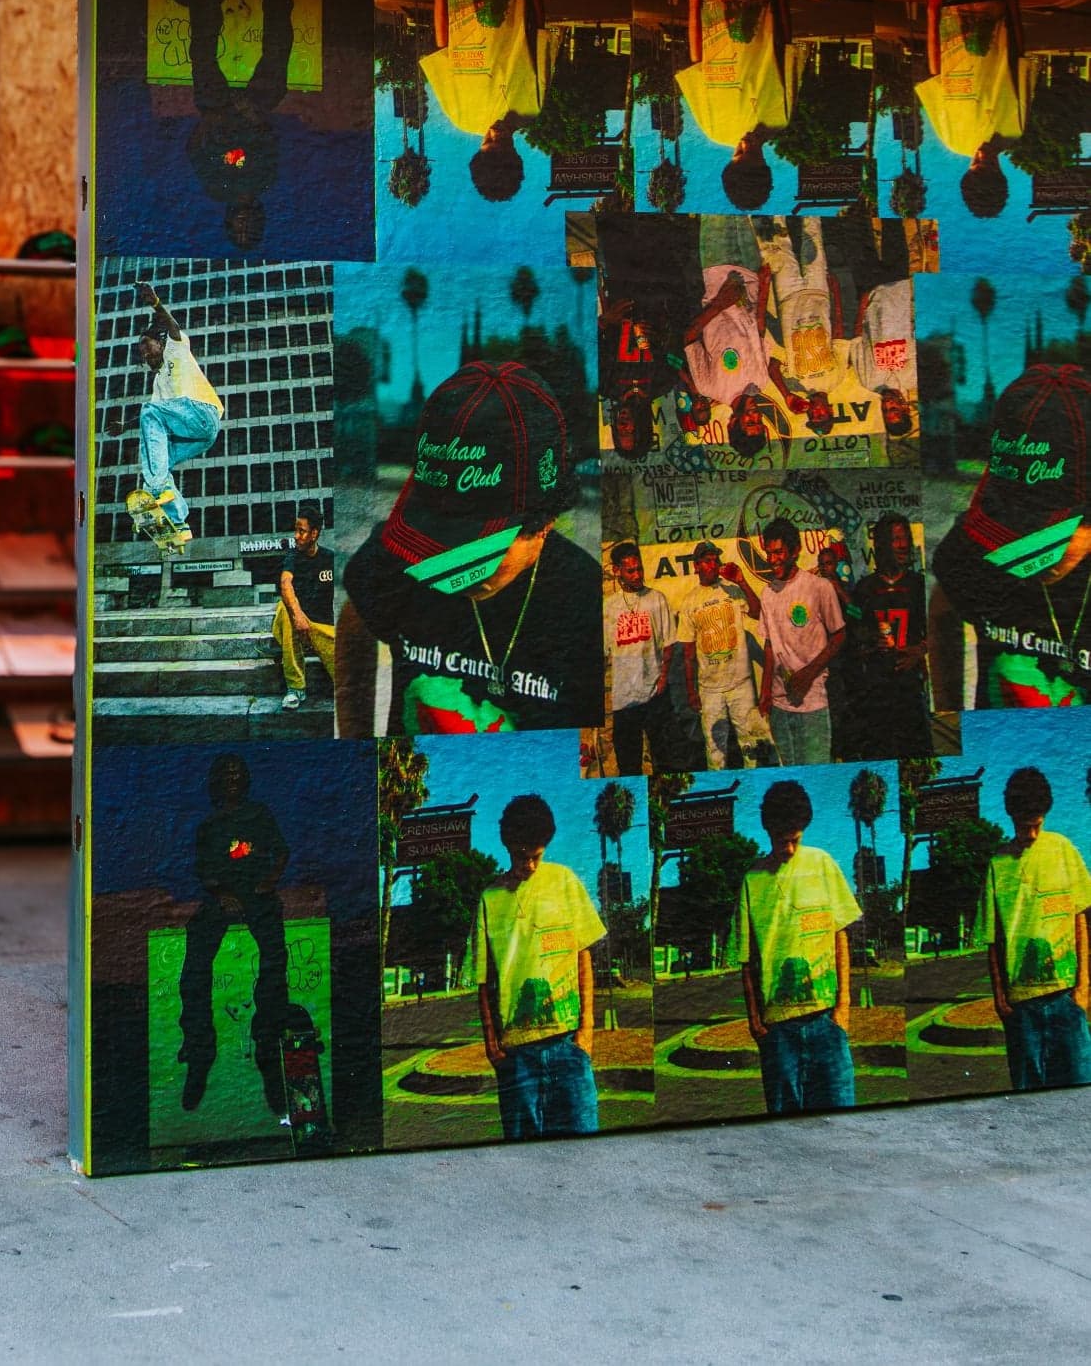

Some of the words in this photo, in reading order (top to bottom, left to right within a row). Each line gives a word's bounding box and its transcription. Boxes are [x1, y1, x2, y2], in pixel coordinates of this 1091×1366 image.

[804, 435, 871, 452] LOTTO
[457, 463, 503, 493] Club
[860, 481, 907, 494] HUGE
[656, 482, 675, 503] NO
[856, 494, 922, 510] SELECTION
[655, 523, 725, 544] LOTTO
[469, 566, 487, 581] 2017
[511, 670, 561, 703] Afrika
